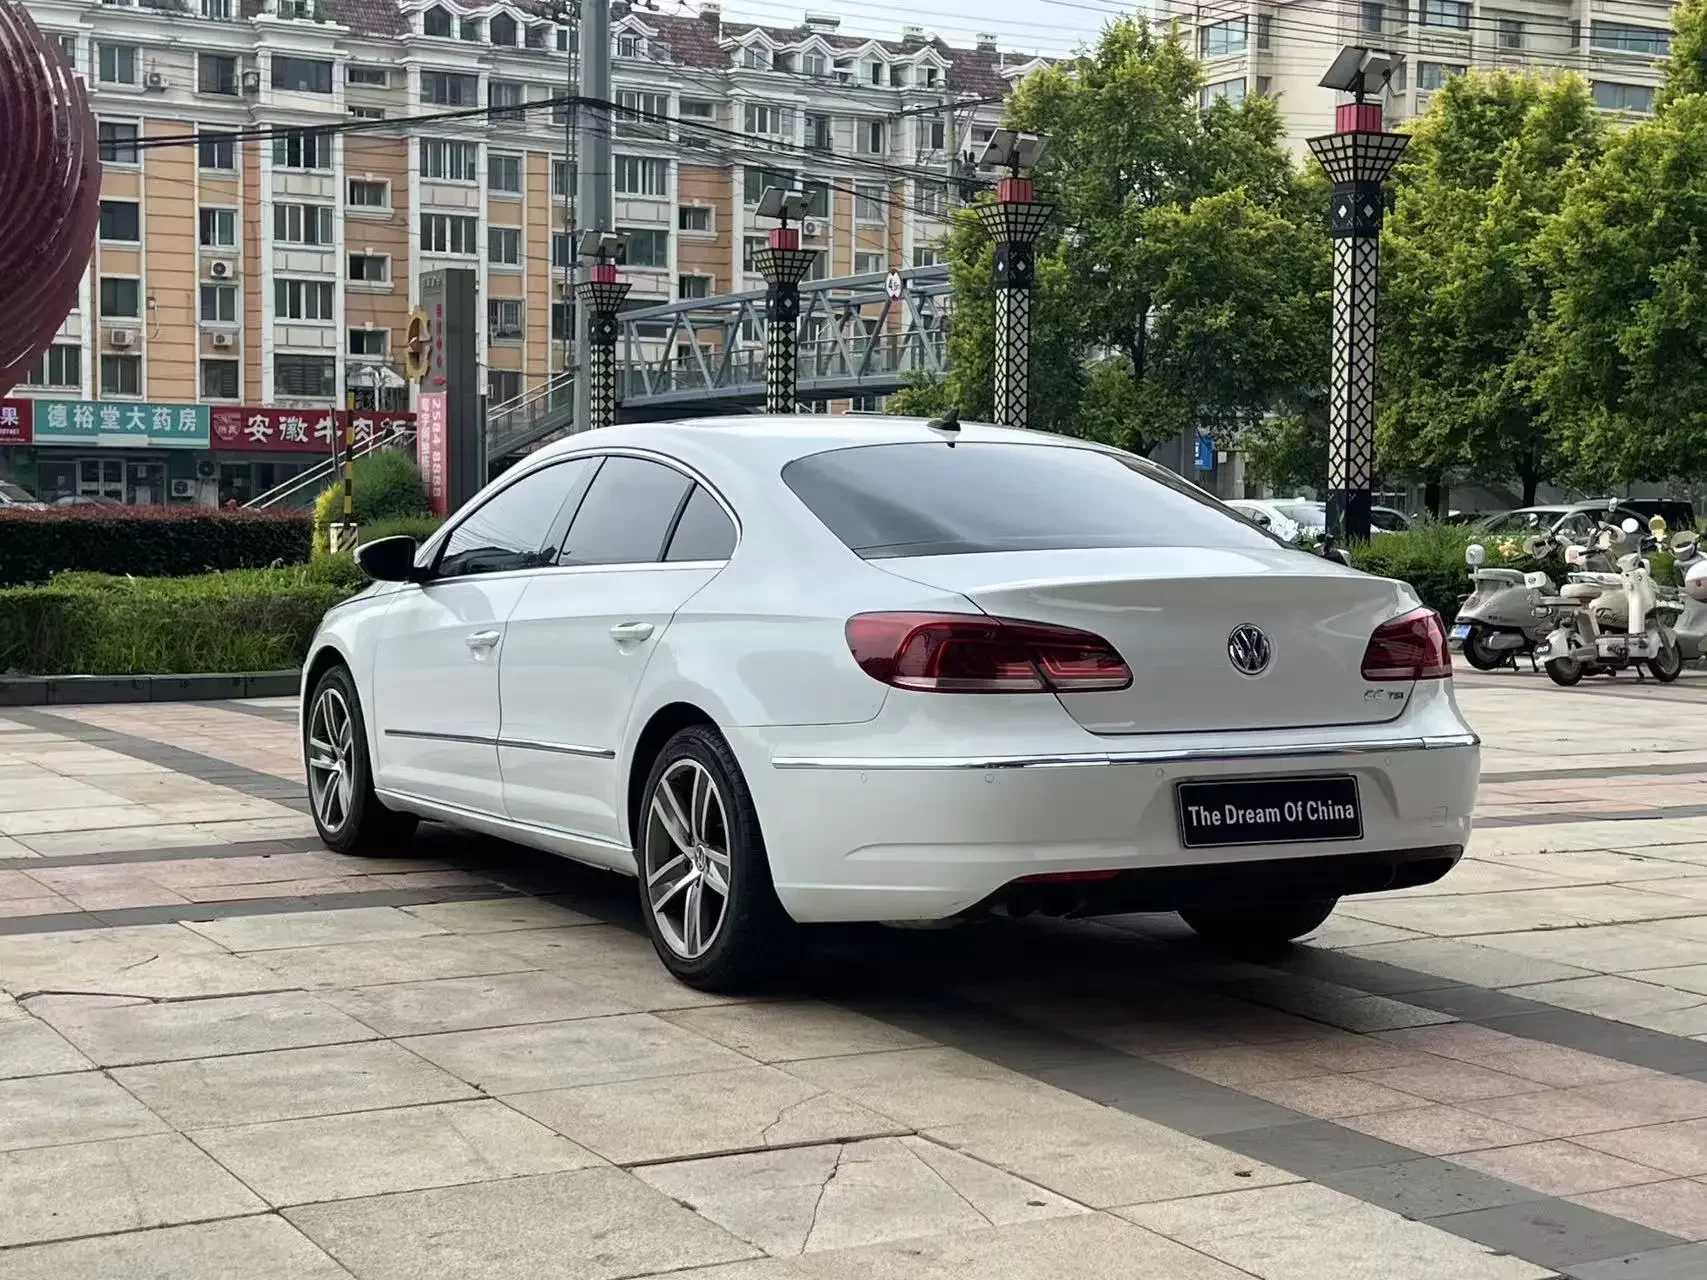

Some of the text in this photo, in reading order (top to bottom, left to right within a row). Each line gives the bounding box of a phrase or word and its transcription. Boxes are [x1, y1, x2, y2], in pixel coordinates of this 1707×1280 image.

[0, 407, 19, 426] 果
[47, 404, 197, 432] 德裕堂大药房
[432, 398, 441, 444] 2584
[1364, 689, 1404, 701] CC TSI
[1188, 799, 1354, 827] The Dream Of China
